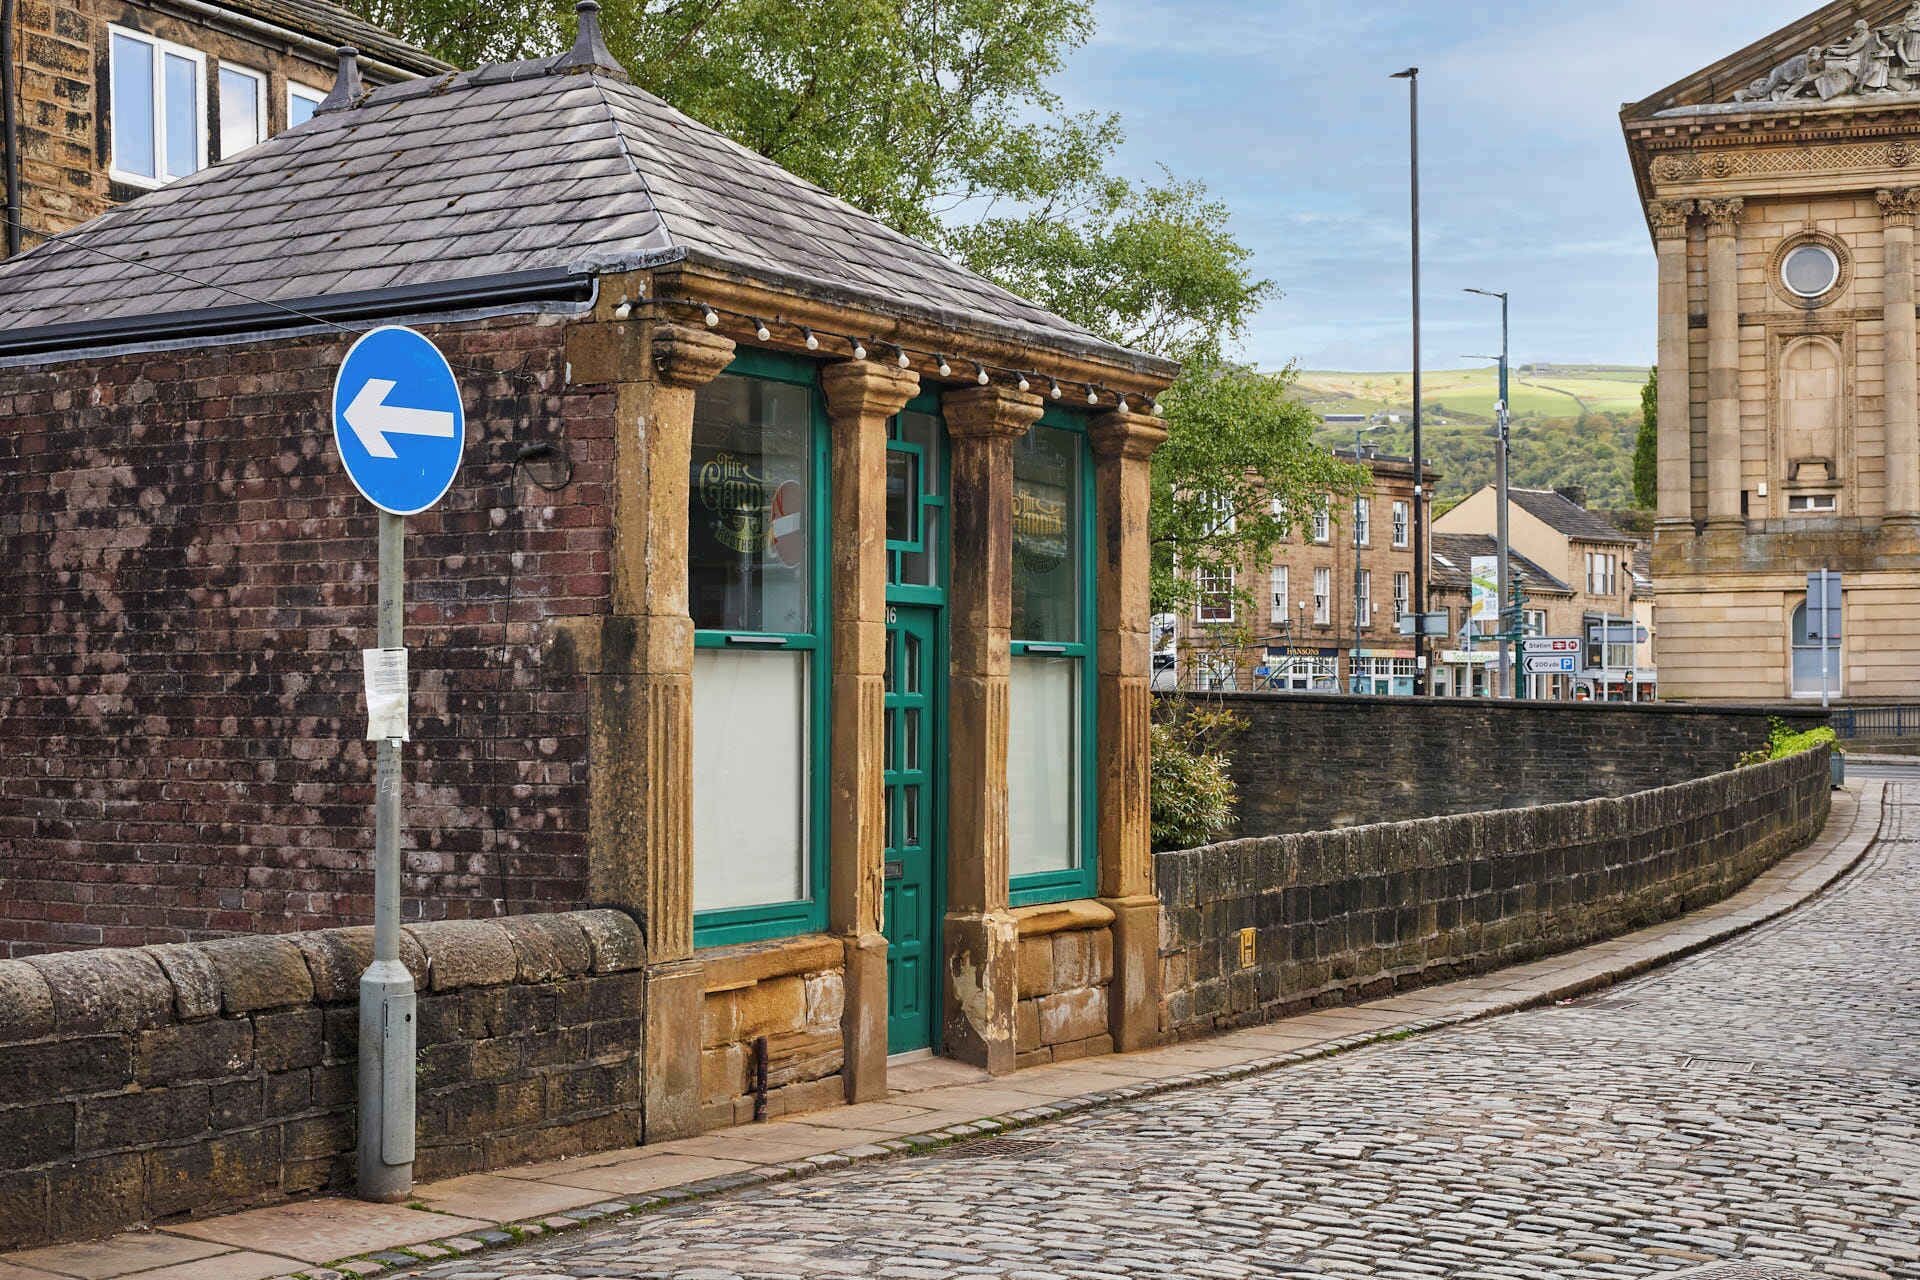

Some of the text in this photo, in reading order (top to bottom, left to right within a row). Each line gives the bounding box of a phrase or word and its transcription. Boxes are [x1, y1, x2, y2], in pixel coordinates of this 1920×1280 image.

[886, 606, 896, 624] 16
[1287, 647, 1319, 656] HANSONS
[1452, 651, 1493, 661] Todorden
